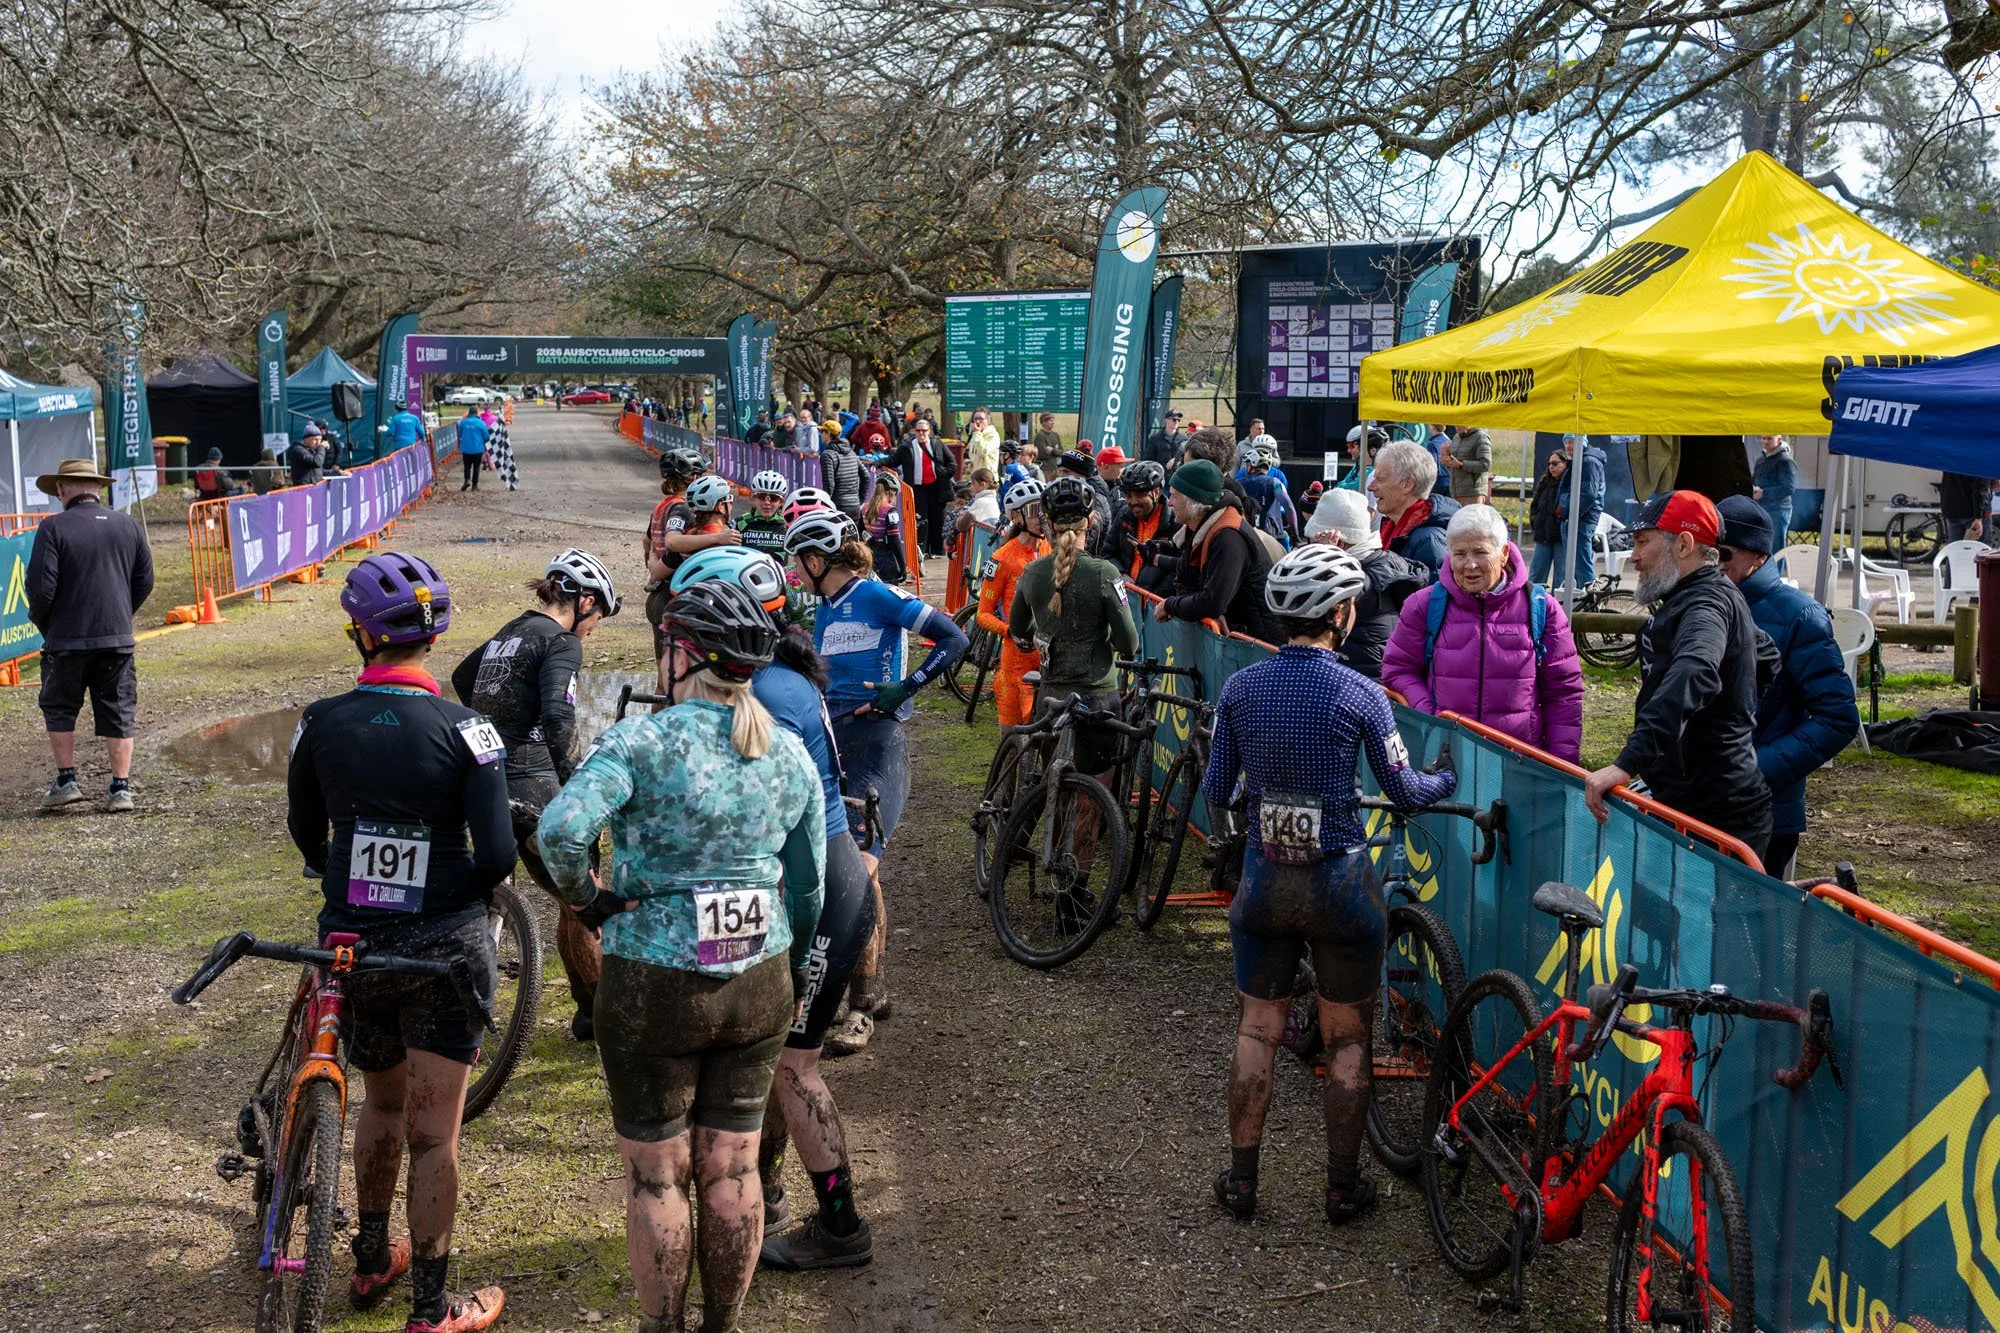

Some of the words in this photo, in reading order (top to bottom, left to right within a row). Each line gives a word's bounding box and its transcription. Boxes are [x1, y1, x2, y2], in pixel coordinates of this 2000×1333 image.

[466, 353, 495, 361] BALLARAT
[536, 347, 562, 357] 2026
[563, 348, 630, 357] AUSCYCLING
[631, 348, 706, 357] CYCLO-CROSS
[536, 356, 590, 364] NATIONAL
[591, 356, 680, 365] CHAMPIONSHIPS
[269, 361, 280, 403] TIMING
[389, 364, 399, 400] National
[1102, 303, 1134, 450] CROSSING
[1391, 369, 1409, 402] THE
[1409, 370, 1431, 405] SUN
[1430, 371, 1442, 405] IS
[1442, 371, 1464, 407] NOT
[1466, 371, 1494, 406] YOUR
[1495, 368, 1535, 404] FRIEND
[1841, 397, 1921, 427] GIANT
[471, 727, 499, 751] 191
[1266, 808, 1313, 843] 149
[361, 841, 418, 882] 191
[368, 884, 379, 902] CX
[704, 894, 765, 935] 154
